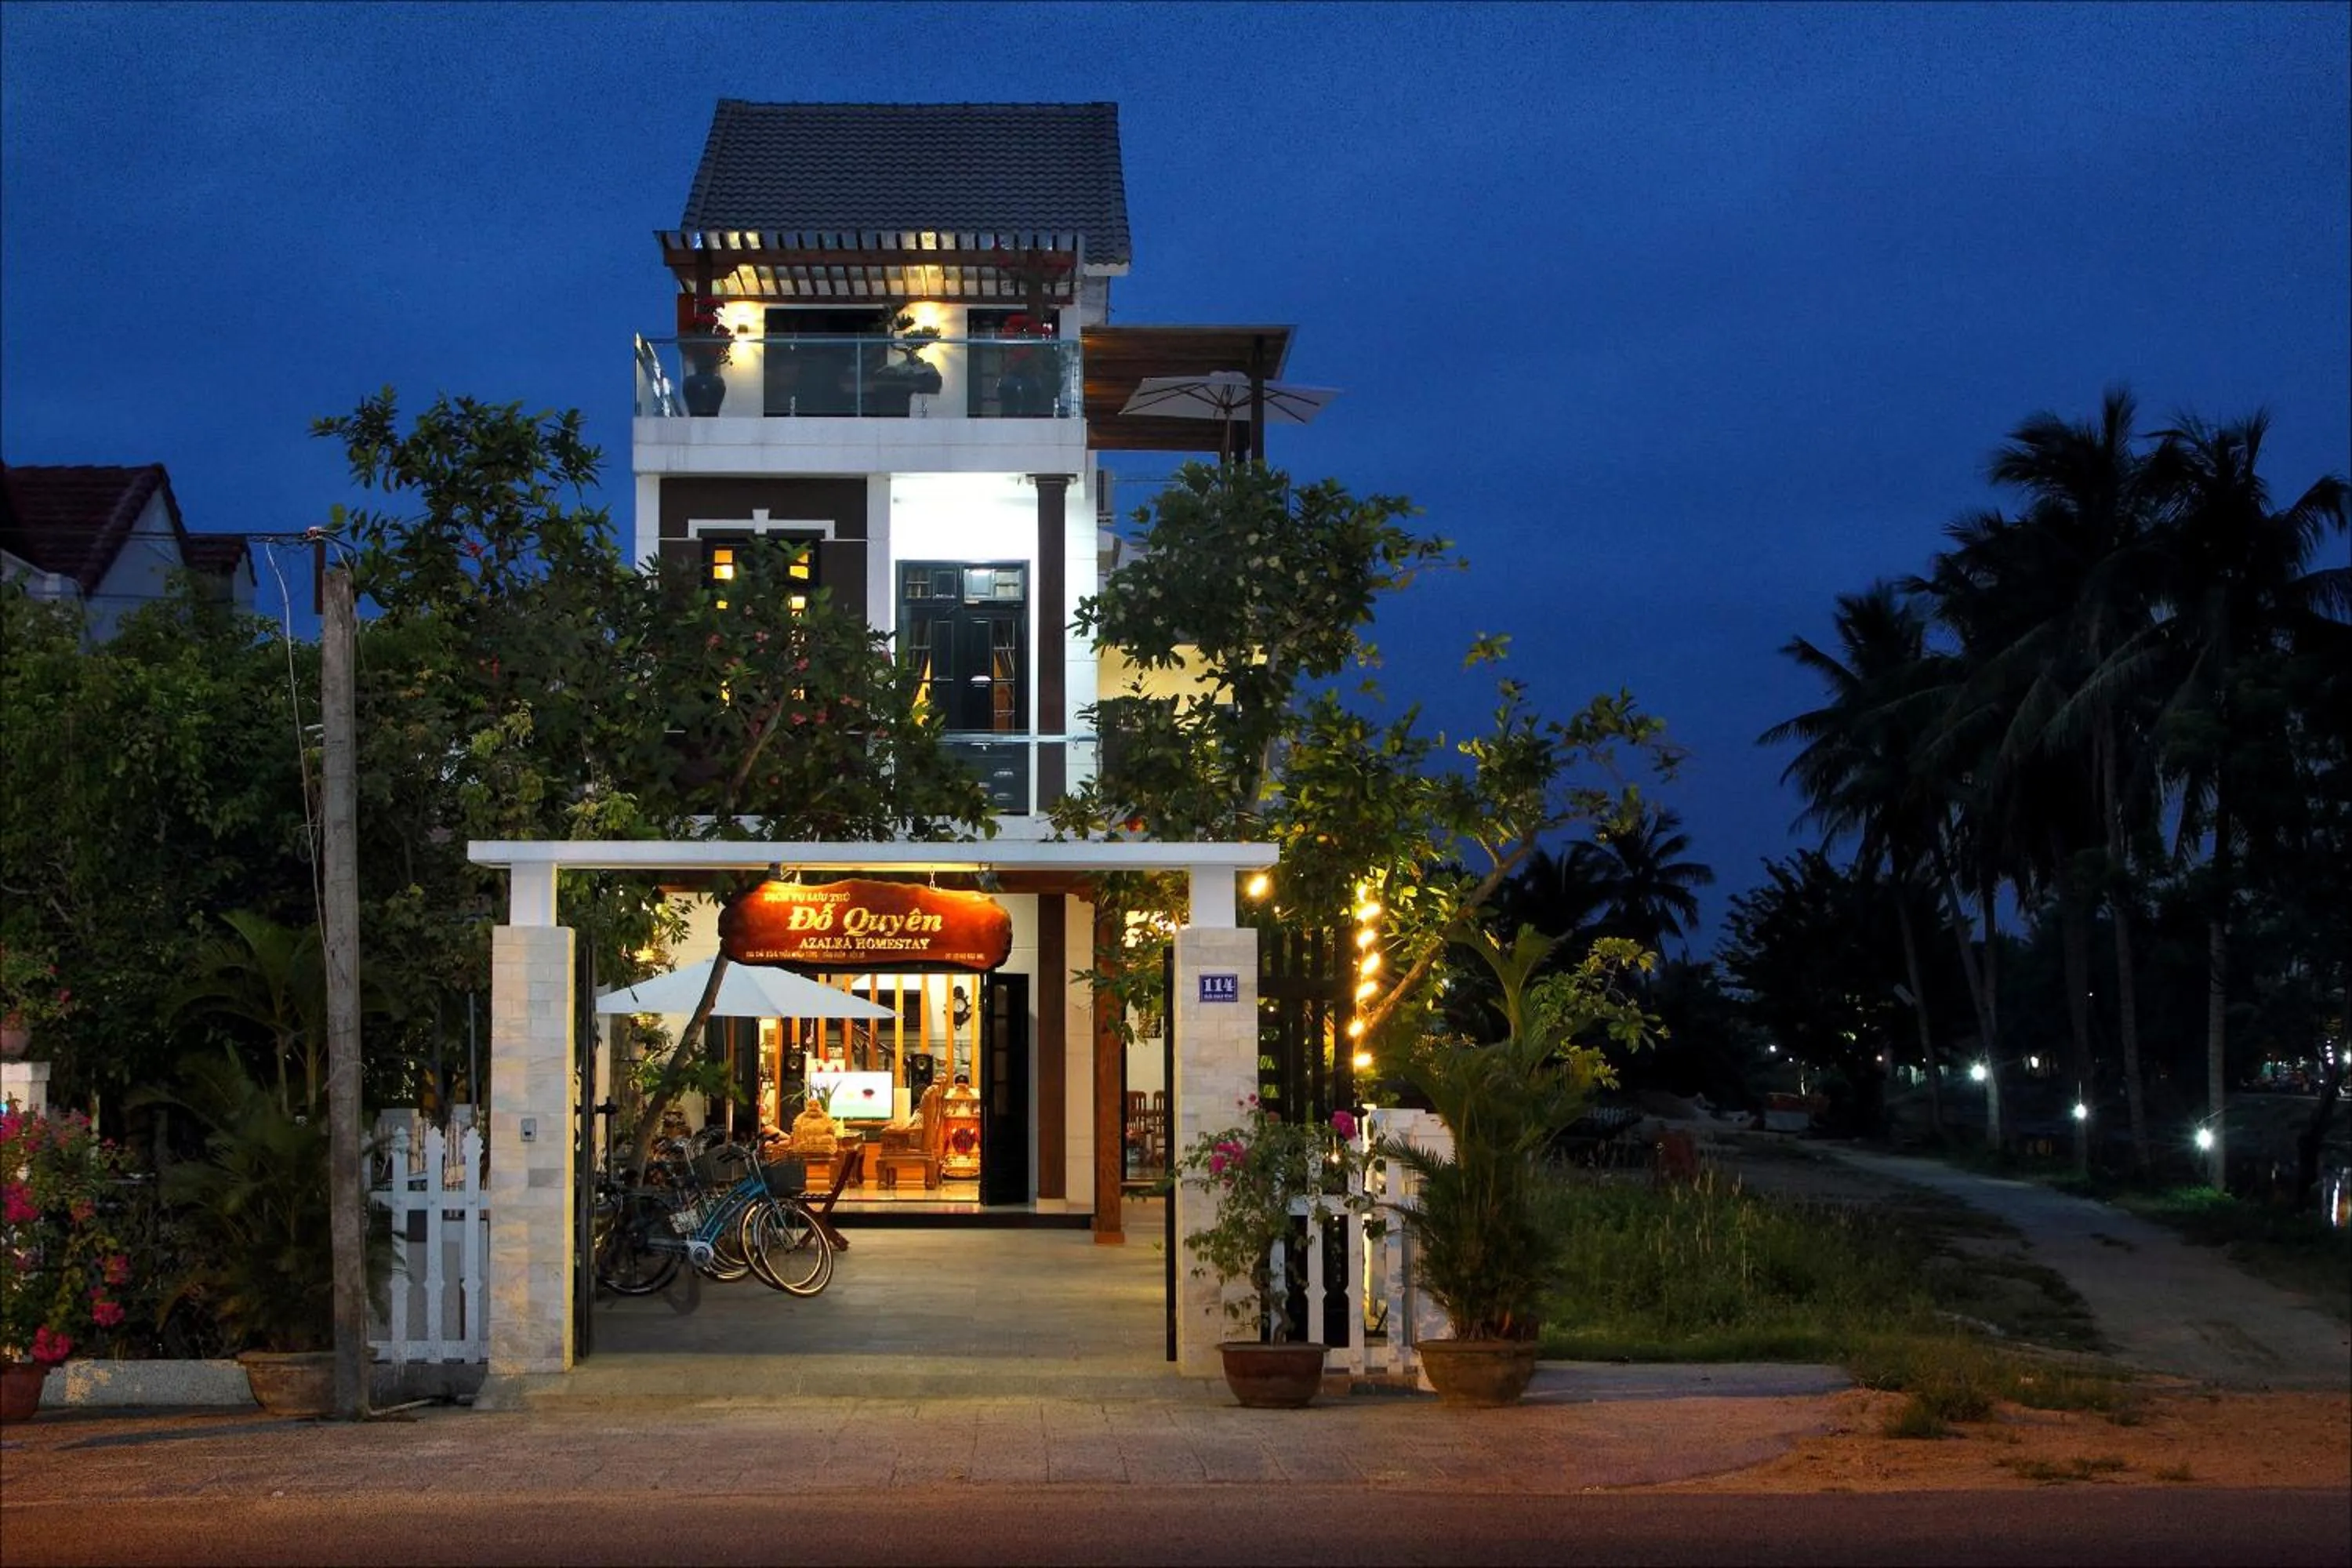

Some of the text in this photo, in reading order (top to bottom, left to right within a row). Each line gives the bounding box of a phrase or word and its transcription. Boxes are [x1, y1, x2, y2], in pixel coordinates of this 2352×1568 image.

[786, 902, 942, 936] Đỗ Quyên
[800, 937, 931, 949] AZALEA HOMESTAY
[1203, 978, 1235, 992] 114
